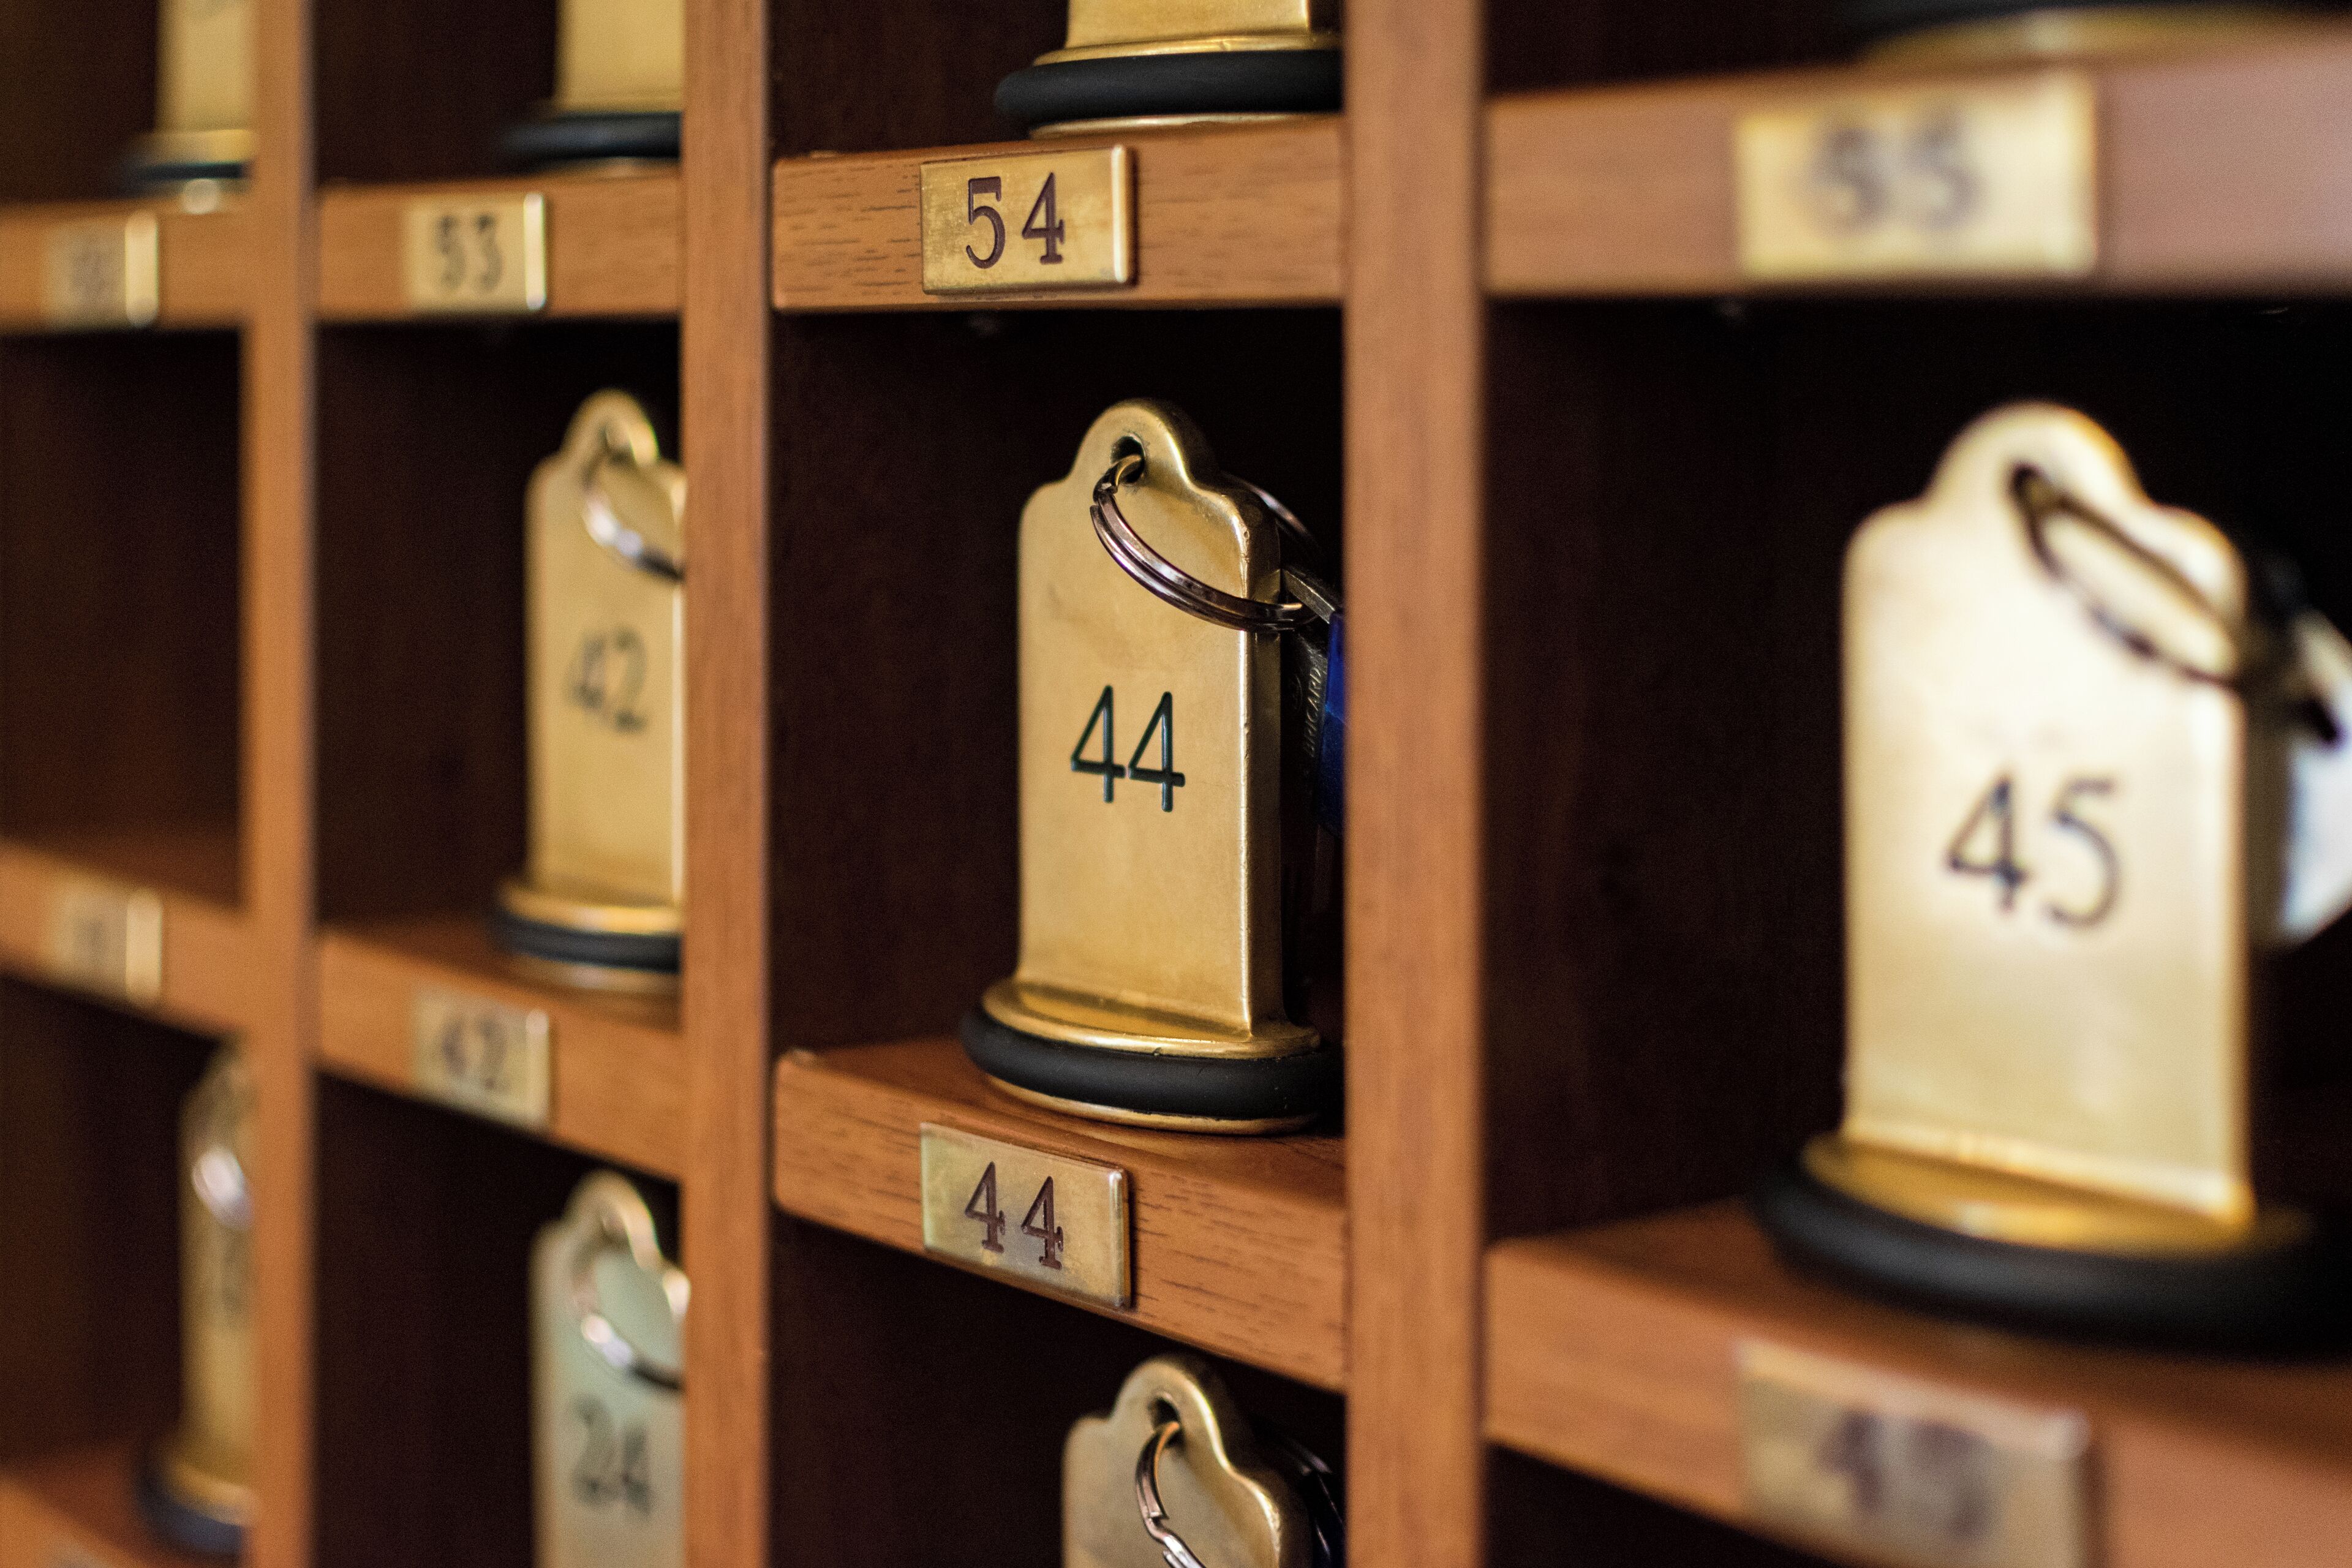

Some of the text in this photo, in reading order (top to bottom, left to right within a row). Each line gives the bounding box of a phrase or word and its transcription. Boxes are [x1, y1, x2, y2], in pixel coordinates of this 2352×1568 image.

[965, 172, 1065, 270] 54
[1070, 684, 1186, 813] 44
[1303, 666, 1322, 758] BRICARD
[1945, 773, 2121, 931] 45
[964, 1161, 1065, 1270] 44
